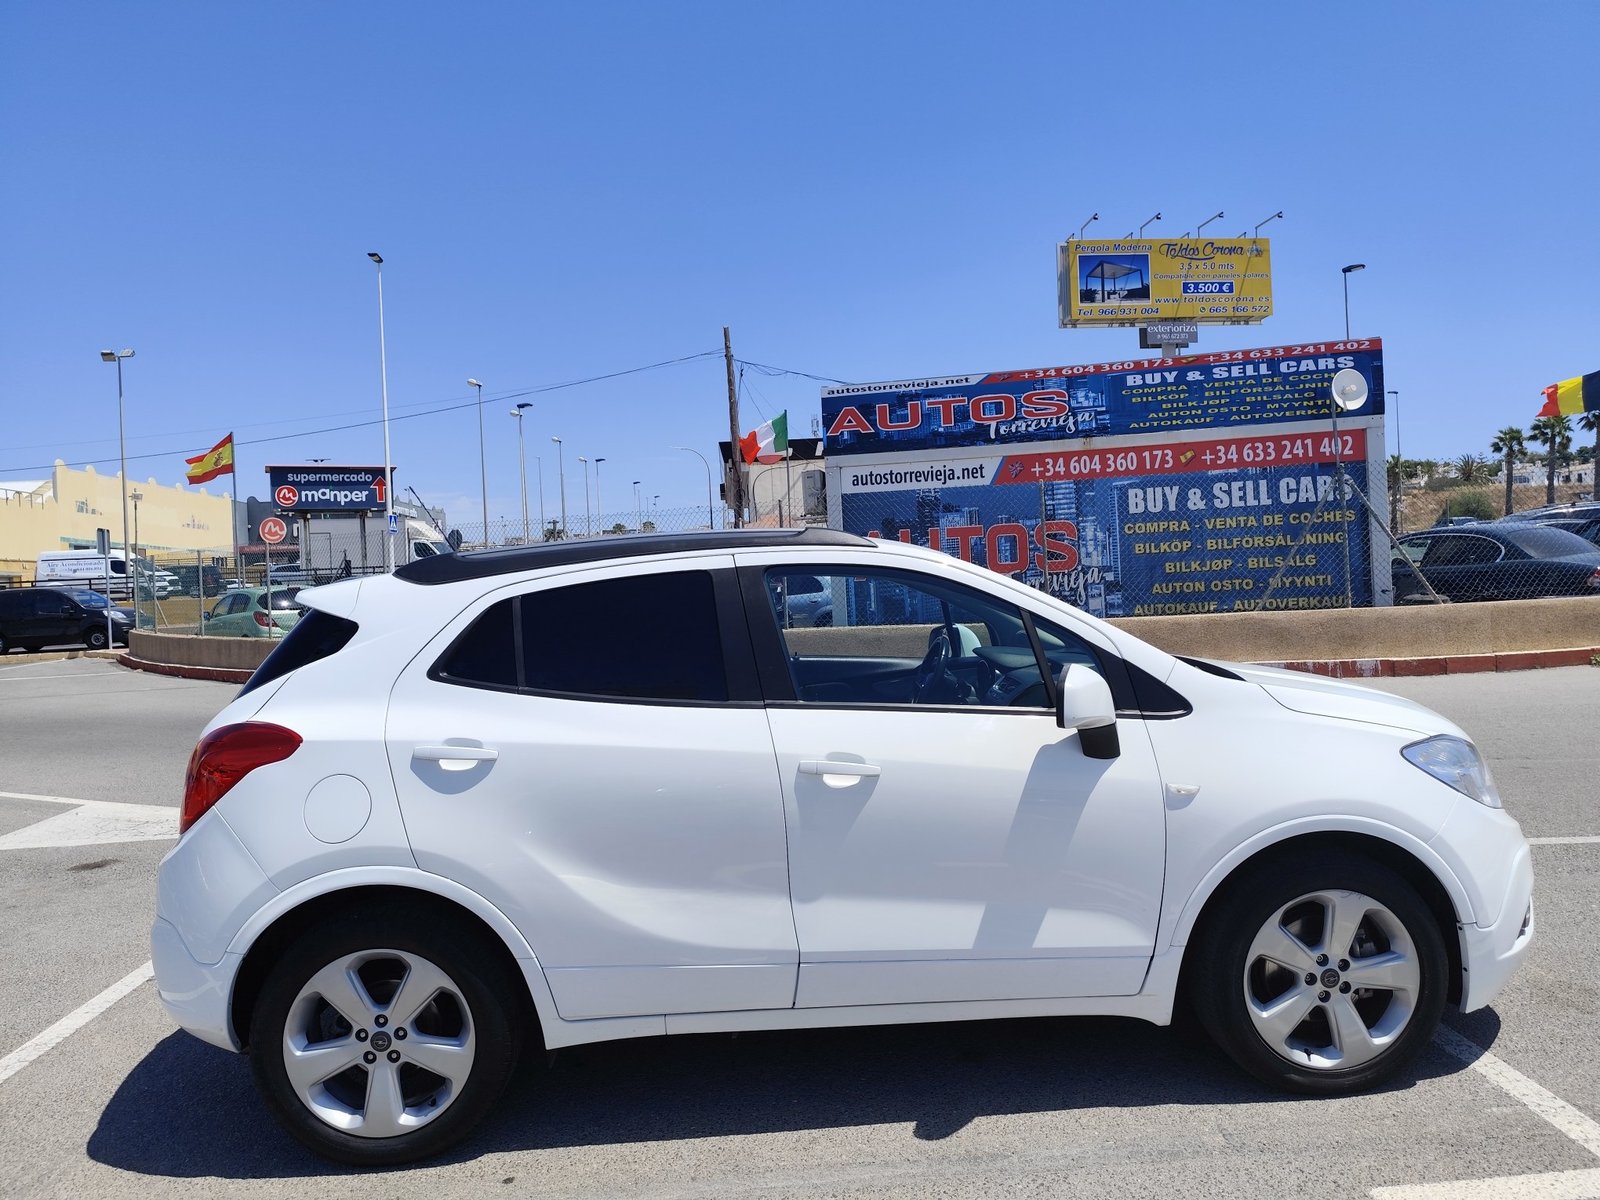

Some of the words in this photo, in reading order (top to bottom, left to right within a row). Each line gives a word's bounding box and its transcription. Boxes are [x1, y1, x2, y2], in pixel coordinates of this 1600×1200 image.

[1075, 244, 1110, 253] Pergola
[1113, 243, 1152, 251] Moderna
[1159, 242, 1199, 258] Toldos
[1202, 242, 1244, 257] Corona
[1179, 262, 1193, 271] 3,5
[1202, 262, 1216, 270] 5,0
[1186, 283, 1220, 293] 3.500
[1222, 283, 1230, 293] €
[1155, 296, 1270, 304] www.toldoscorona.es
[1141, 307, 1159, 315] 004
[1147, 323, 1196, 333] exterioriza
[827, 376, 970, 396] autostorrevieja.net
[1020, 368, 1056, 379] +34
[1062, 364, 1095, 376] 604
[1101, 362, 1134, 371] 360
[1140, 358, 1173, 367] 173
[1204, 351, 1244, 362] +34
[1250, 348, 1284, 358] 633
[1292, 344, 1326, 354] 241
[1334, 340, 1370, 350] 402
[1126, 371, 1178, 386] BUY
[1186, 370, 1204, 381] &
[1212, 364, 1272, 379] SELL
[1280, 356, 1354, 374] CARS
[1122, 384, 1188, 394] COMPRA
[1204, 378, 1256, 388] VENTA
[1288, 372, 1336, 381] COCH
[1132, 392, 1190, 403] BILKÖP
[1162, 398, 1230, 409] BILKJØP
[1246, 392, 1316, 402] BILSALG
[827, 389, 1069, 436] AUTOS
[1148, 408, 1202, 418] AUTON
[1208, 406, 1250, 414] OSTO
[983, 411, 1095, 439] Torrevieja
[1129, 417, 1214, 428] AUTOKAUF
[852, 463, 985, 487] autostorrevieja.net
[1031, 458, 1066, 477] +34
[1070, 454, 1101, 474] 604
[1106, 452, 1138, 472] 360
[1143, 450, 1174, 469] 173
[1201, 445, 1238, 464] +34
[1243, 442, 1276, 462] 633
[1282, 439, 1313, 460] 241
[1320, 436, 1354, 456] 402
[287, 472, 372, 483] supermercado
[301, 488, 369, 506] manper
[1128, 486, 1179, 514] BUY
[1187, 487, 1206, 511] &
[1212, 479, 1272, 509] SELL
[1124, 520, 1190, 534] COMPRA
[1204, 516, 1256, 530] VENTA
[1264, 514, 1283, 526] DE
[1135, 538, 1192, 554] BILKÖP
[1165, 558, 1232, 574] BILKJØP
[1152, 580, 1204, 594] AUTON
[1210, 578, 1254, 592] OSTO
[1134, 602, 1218, 616] AUTOKAUF
